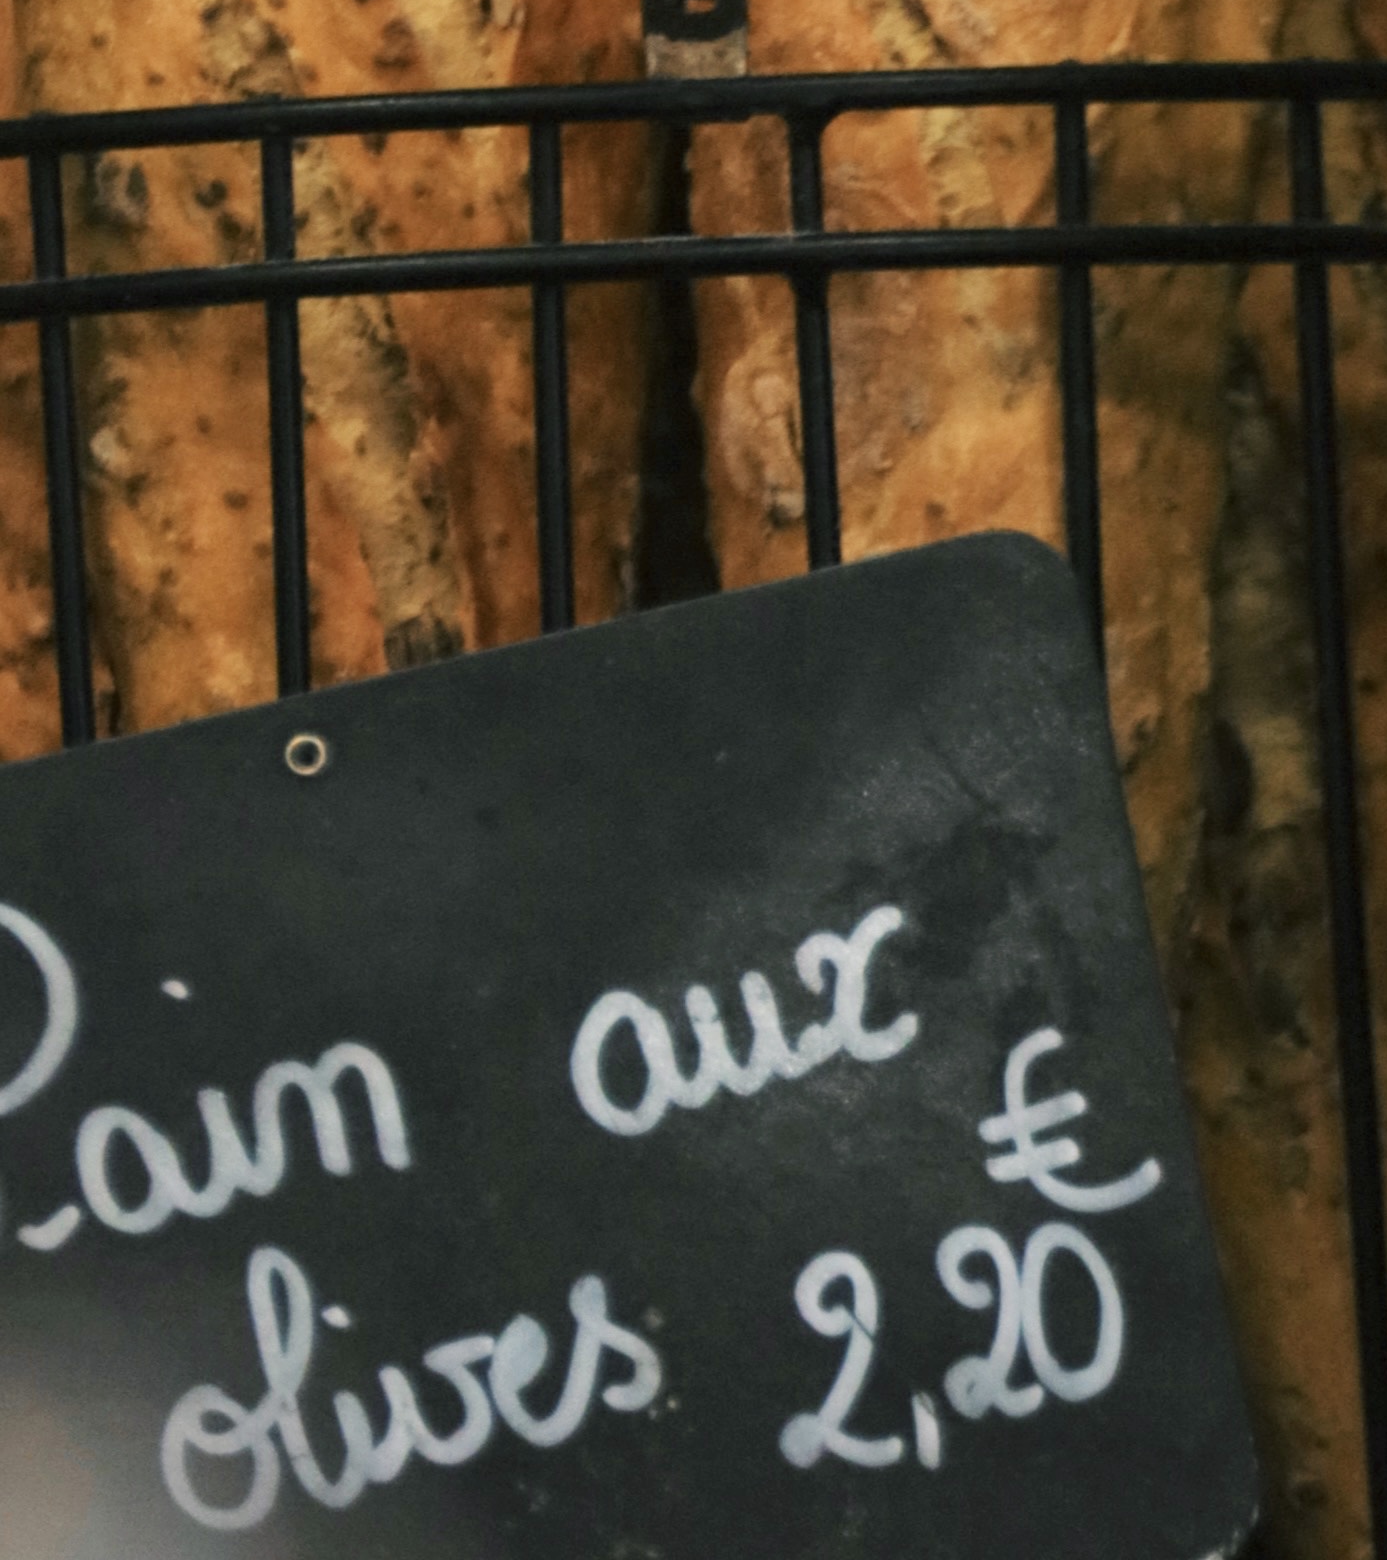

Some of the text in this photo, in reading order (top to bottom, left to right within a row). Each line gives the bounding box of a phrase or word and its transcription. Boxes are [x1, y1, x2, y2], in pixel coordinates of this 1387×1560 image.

[570, 904, 921, 1138] aux
[978, 1028, 1162, 1214] €
[160, 1220, 1126, 1532] olives 2,20
